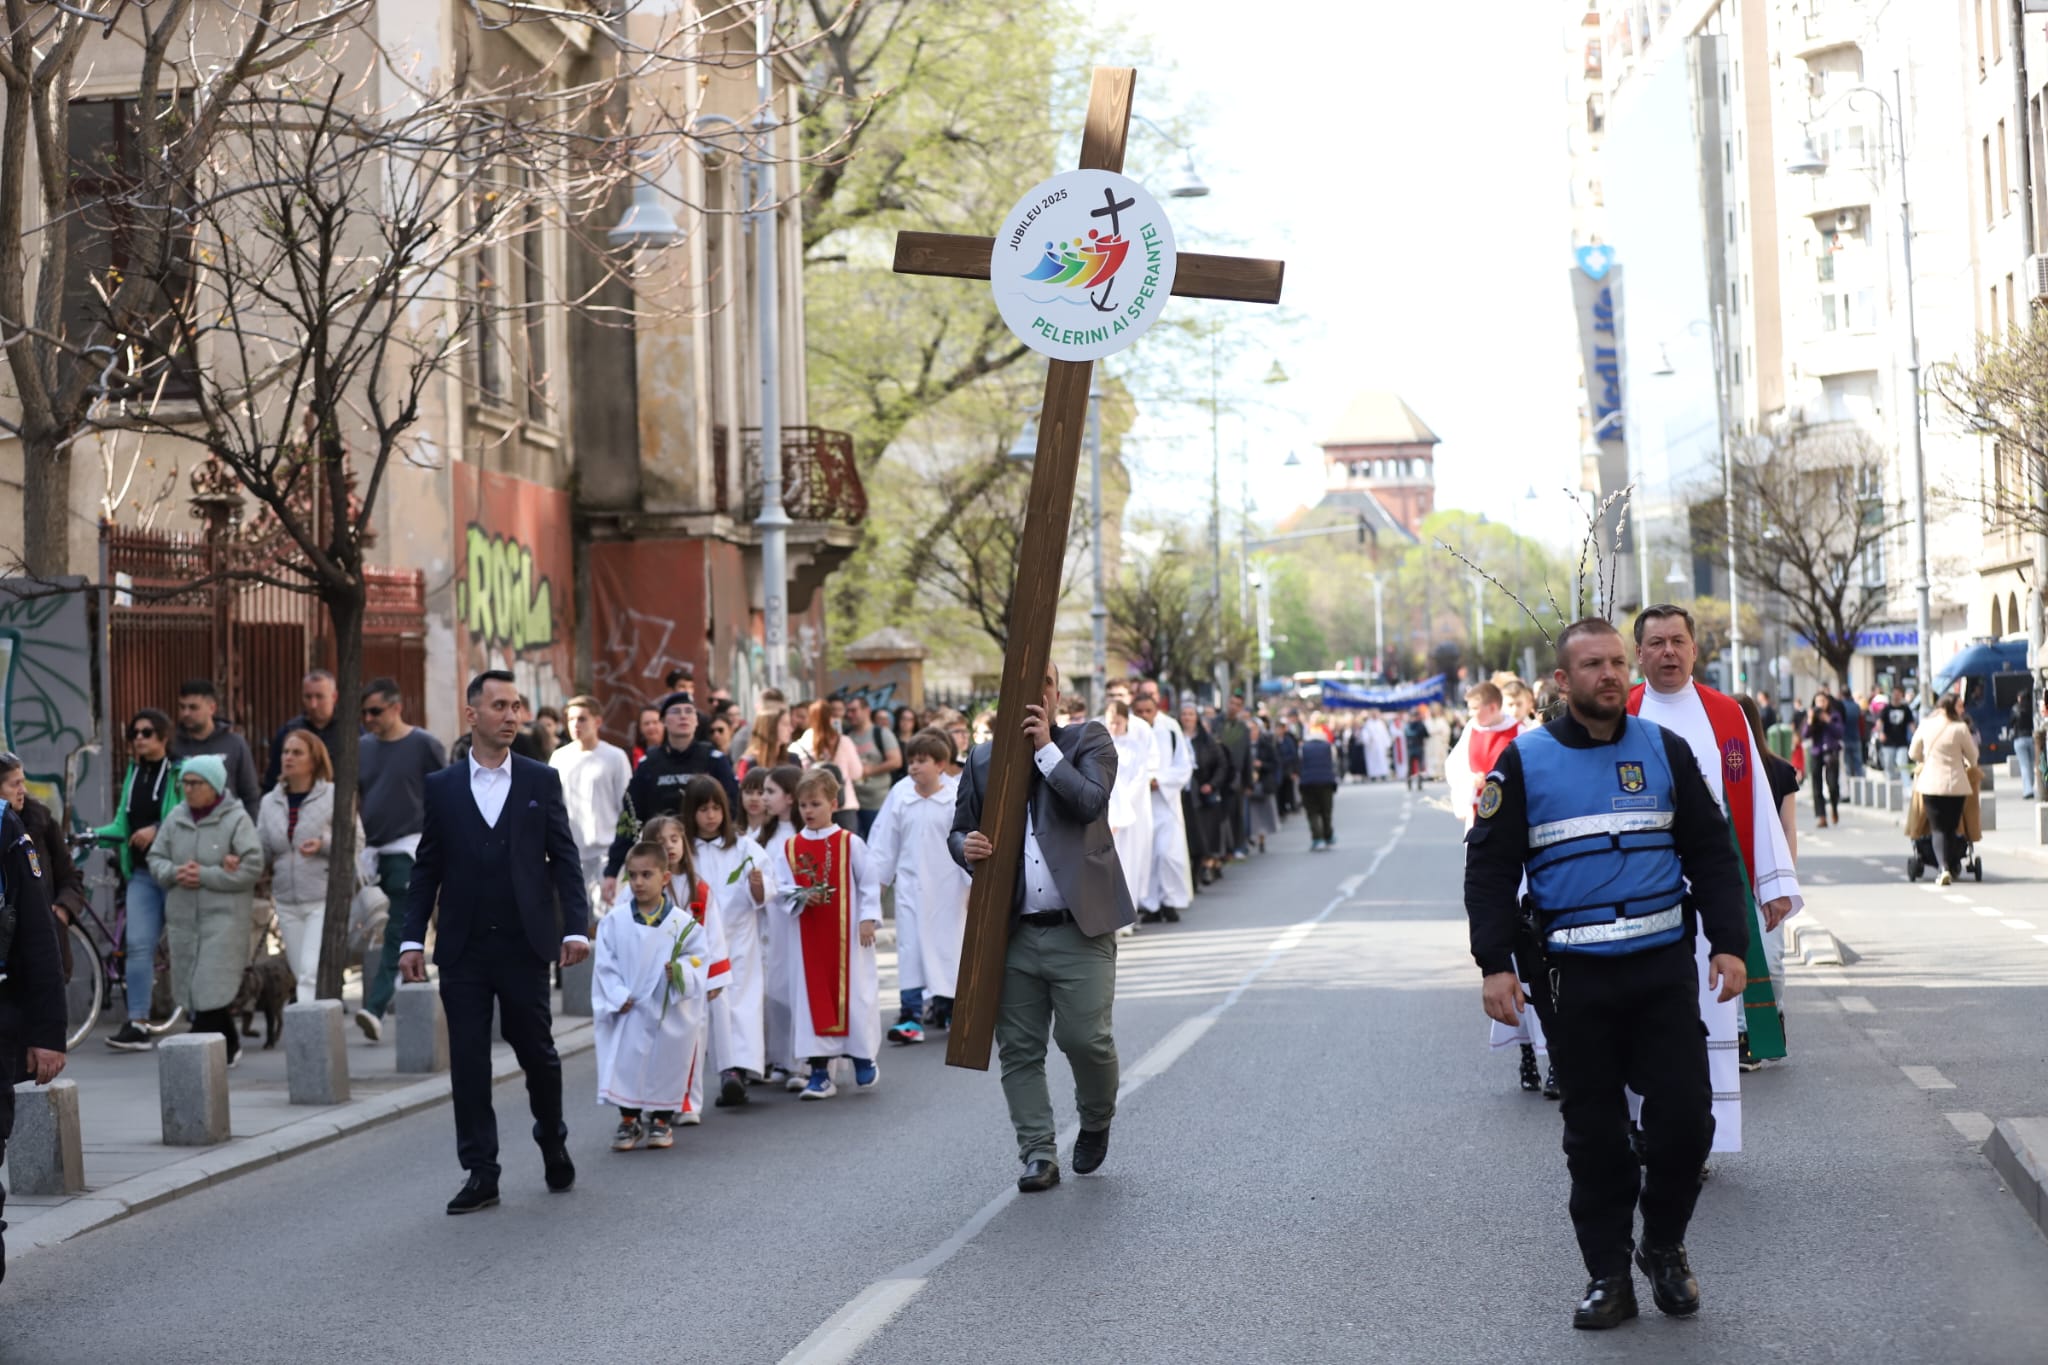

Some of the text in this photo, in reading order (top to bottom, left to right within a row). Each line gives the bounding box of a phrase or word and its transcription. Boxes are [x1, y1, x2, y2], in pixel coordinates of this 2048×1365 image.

[1010, 188, 1068, 251] JUBILEU 2025
[1032, 222, 1164, 345] PELERINI AI SPERANȚEI
